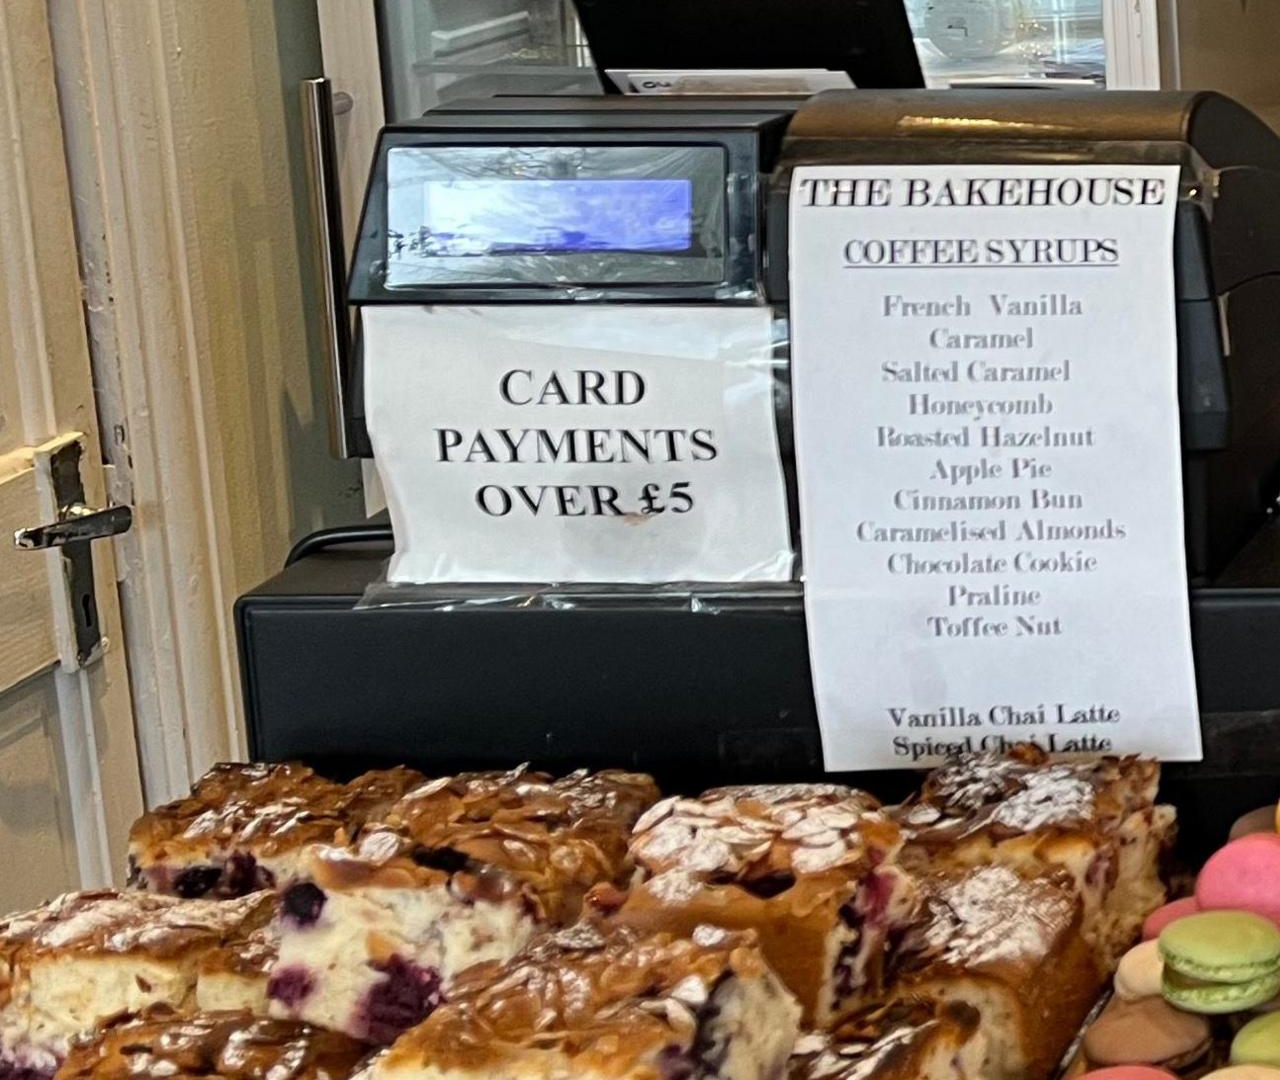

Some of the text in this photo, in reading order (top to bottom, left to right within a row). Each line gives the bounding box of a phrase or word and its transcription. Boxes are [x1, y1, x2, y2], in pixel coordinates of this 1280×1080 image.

[801, 177, 1166, 208] THE BAKEHOUSE
[844, 238, 1120, 266] COFFEE SYRUPS
[882, 294, 1083, 317] French Vanilla
[929, 328, 1035, 350] Caramel
[881, 360, 1071, 383] Salted Caramel
[499, 369, 647, 406] CARD
[908, 393, 1054, 421] Honeycomb
[434, 428, 719, 464] PAYMENTS
[876, 426, 1096, 448] Roasted Hazelnut
[929, 458, 1053, 485] Apple Pie
[475, 481, 695, 517] OVER £5
[894, 489, 1084, 512] Cinnamon Bun
[856, 519, 1127, 542] Caramelised Almonds
[887, 552, 1099, 575] Chocolate Cookie
[948, 585, 1042, 607] Praline
[926, 616, 1063, 638] Toffee Nut
[887, 703, 1122, 729] Vanilla Chai Latte
[893, 736, 974, 762] Spiced
[1048, 734, 1113, 755] Latte
